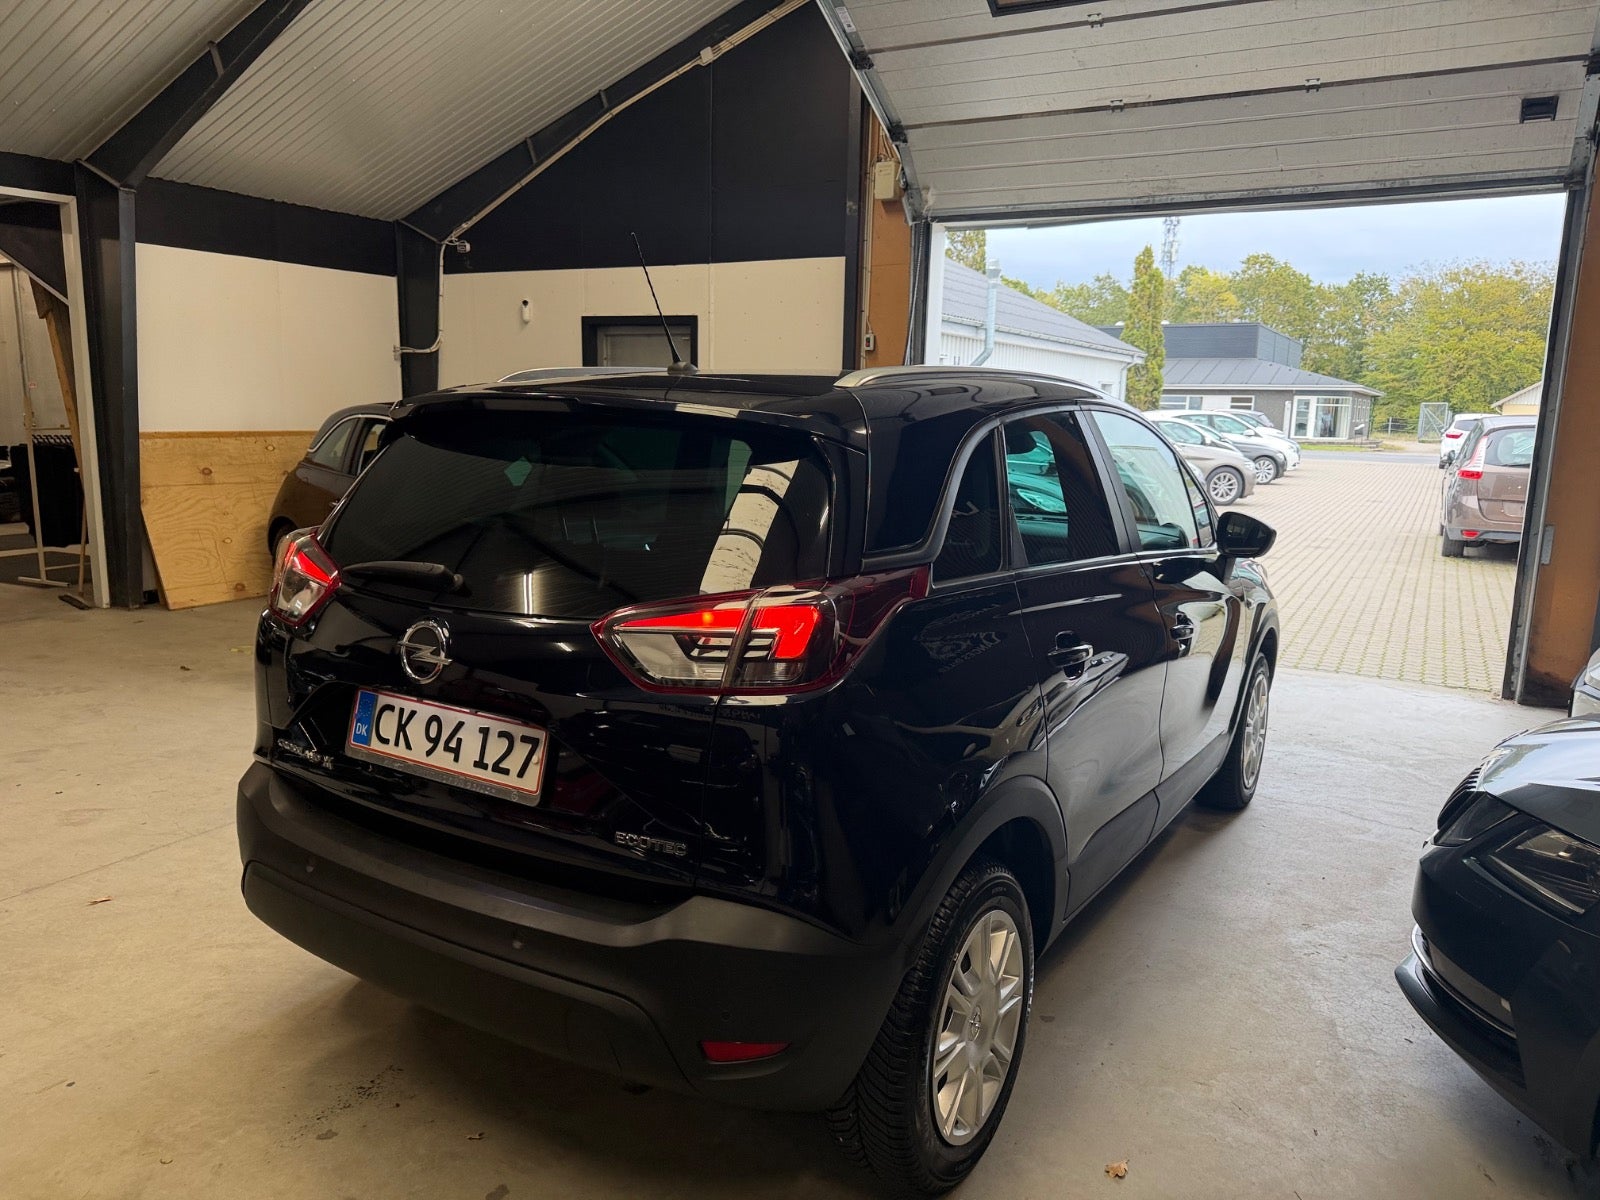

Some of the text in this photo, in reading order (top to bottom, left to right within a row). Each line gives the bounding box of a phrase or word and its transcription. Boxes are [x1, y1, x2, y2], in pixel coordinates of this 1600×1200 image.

[355, 722, 369, 737] DK
[374, 703, 418, 751] CK
[424, 714, 466, 763] 94
[472, 726, 541, 779] 127
[615, 831, 688, 857] ECOTEC
